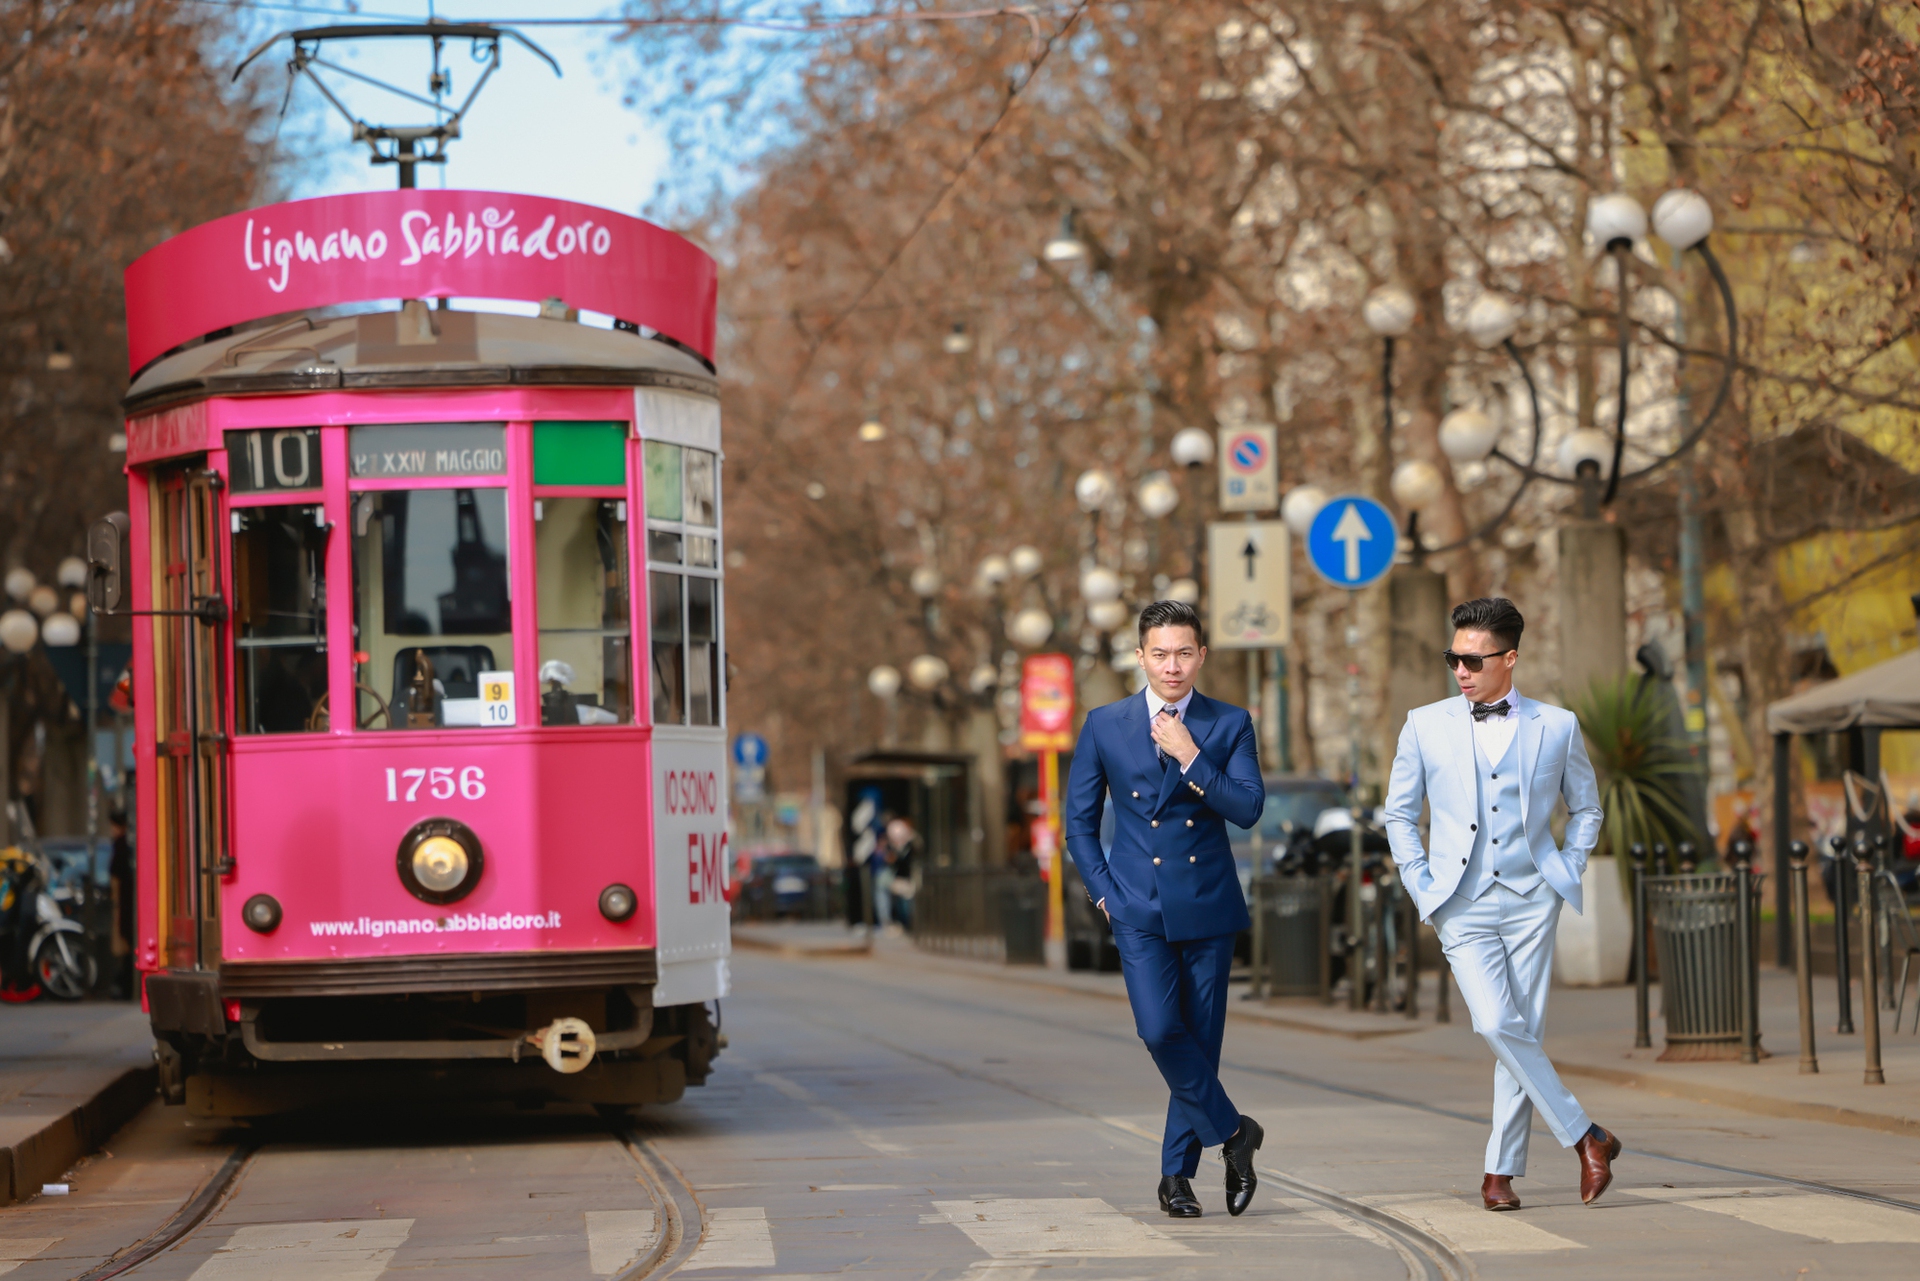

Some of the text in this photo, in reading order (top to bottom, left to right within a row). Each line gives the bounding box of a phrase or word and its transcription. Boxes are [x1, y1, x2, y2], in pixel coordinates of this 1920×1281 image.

[244, 207, 611, 293] Lignano Sabbiadoro
[246, 430, 310, 489] 10
[382, 451, 425, 473] XXIV
[435, 449, 502, 473] MAGGIO
[491, 683, 503, 701] 9
[488, 704, 508, 721] 10
[385, 765, 487, 802] 1756
[664, 770, 717, 815] IO SONO
